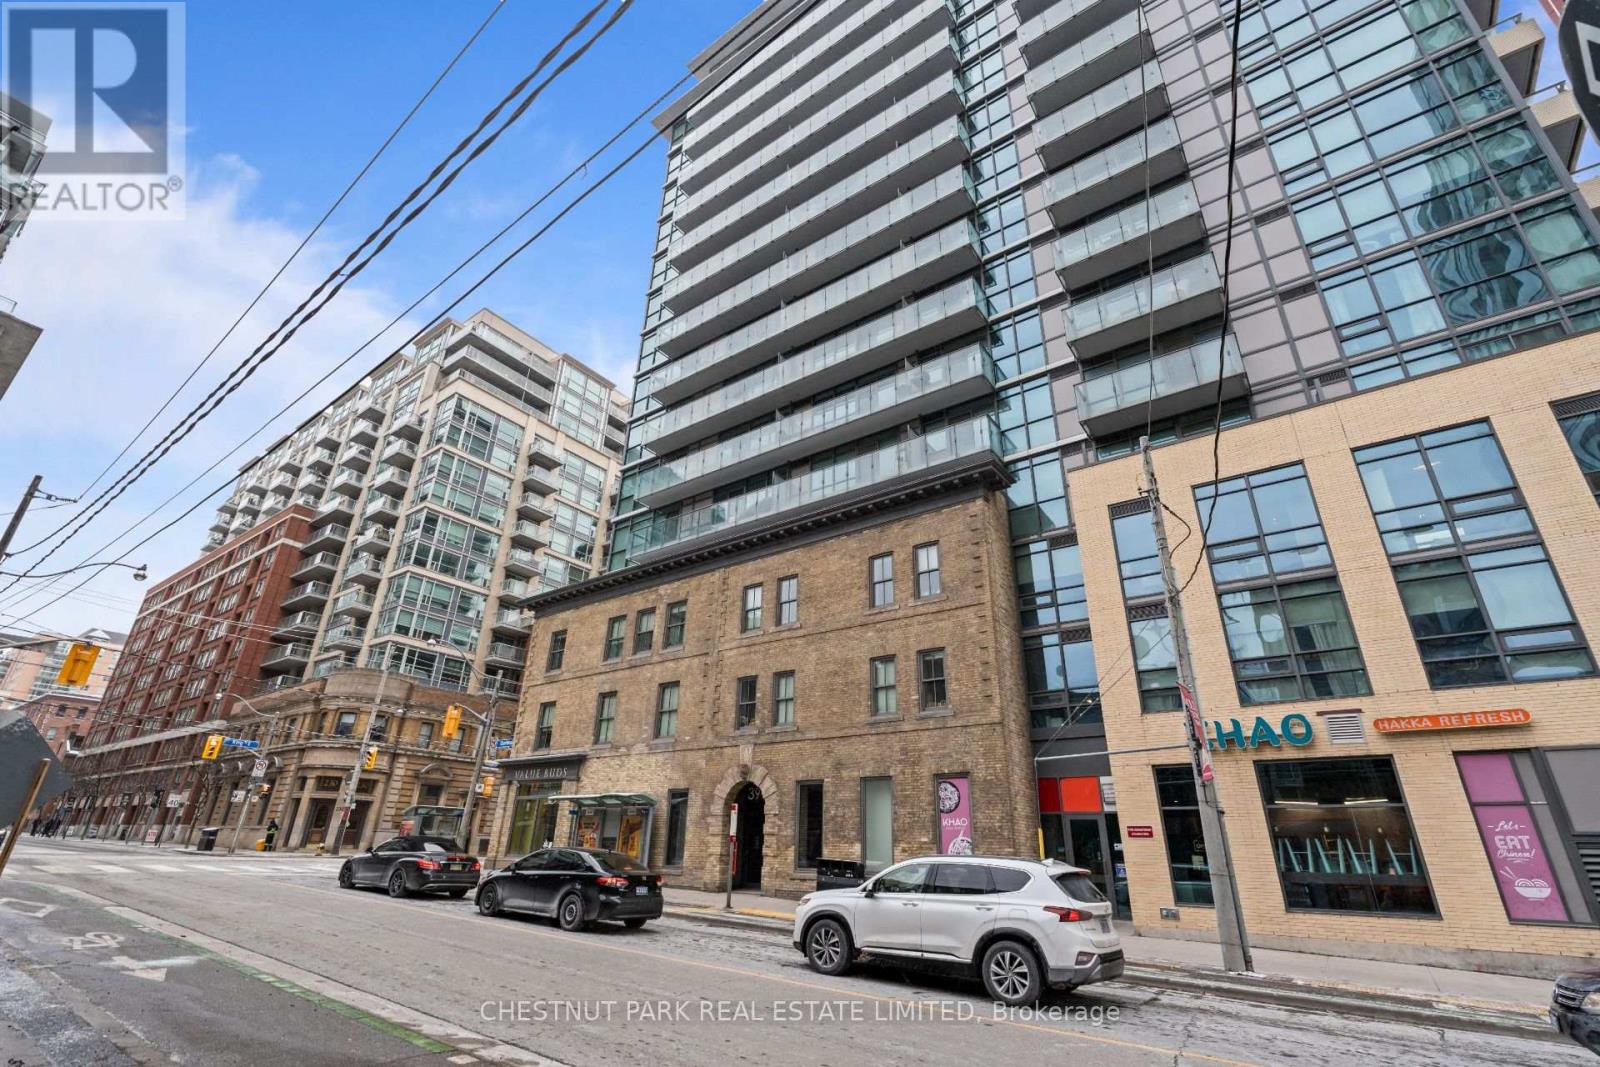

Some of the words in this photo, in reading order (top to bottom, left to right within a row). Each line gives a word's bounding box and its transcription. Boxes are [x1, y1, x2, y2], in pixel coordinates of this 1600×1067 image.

[1378, 717, 1433, 730] HAKKA
[1439, 711, 1526, 726] REFRESH
[1203, 713, 1313, 749] HAO
[514, 768, 541, 779] VALUE
[543, 767, 568, 778] BUDS
[747, 787, 761, 800] 39
[942, 817, 968, 826] KHAO
[1494, 835, 1530, 849] EAT
